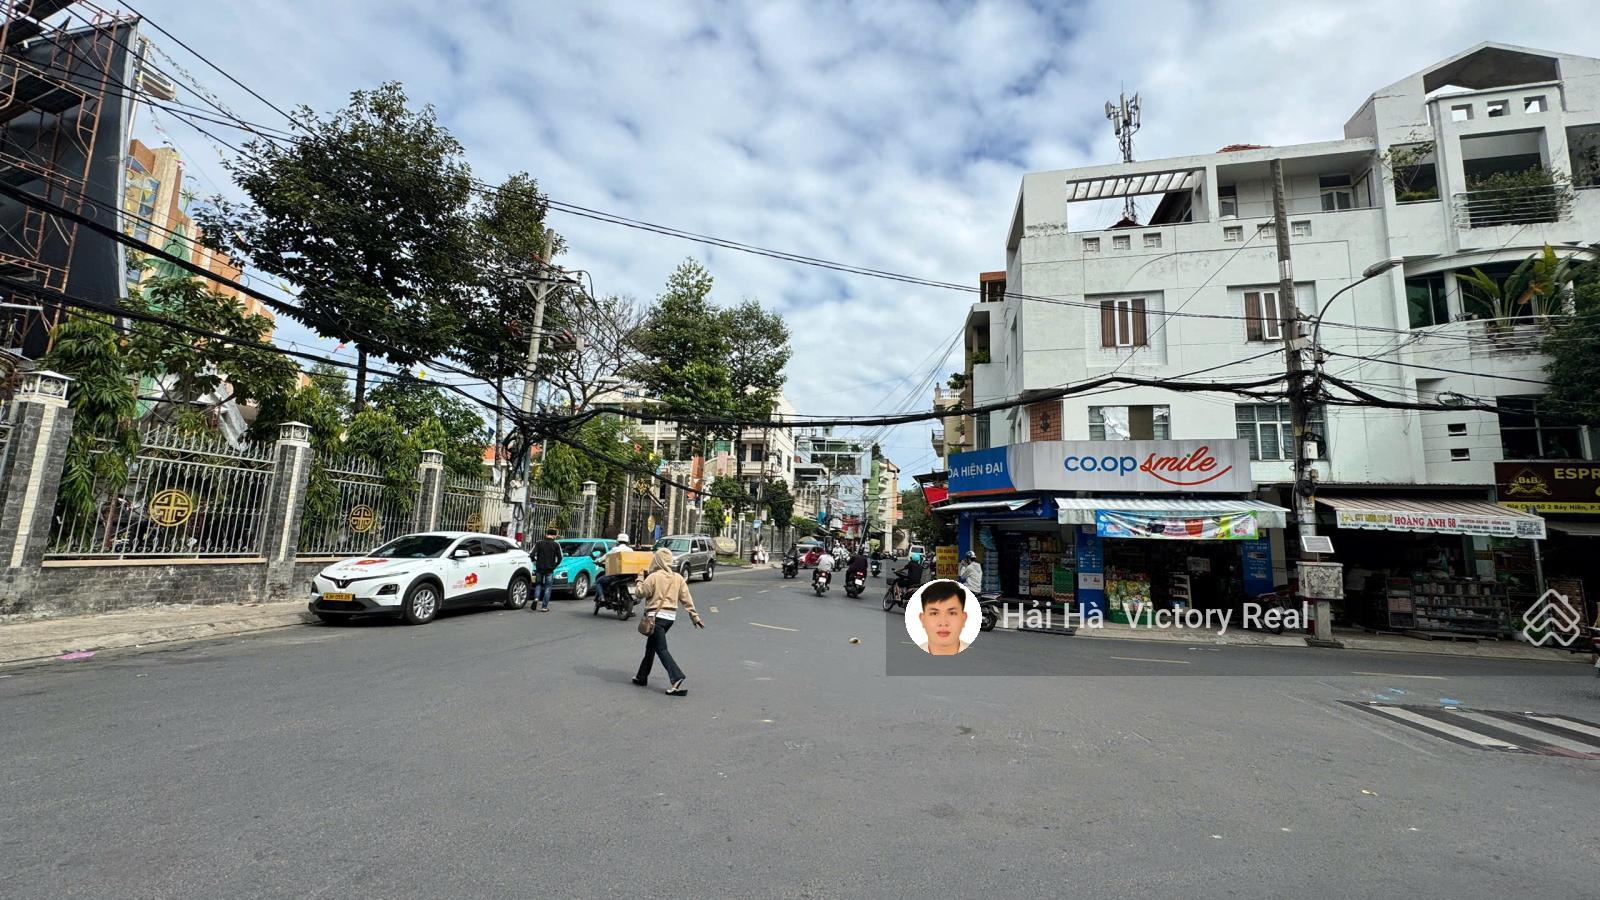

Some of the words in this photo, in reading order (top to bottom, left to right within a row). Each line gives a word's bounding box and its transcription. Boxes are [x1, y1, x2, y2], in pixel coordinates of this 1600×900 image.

[1064, 455, 1137, 476] co.op
[1139, 446, 1218, 473] smile
[961, 463, 982, 478] HIỆN
[985, 461, 1003, 477] ĐẠI
[1554, 468, 1600, 479] ESPR
[1394, 514, 1425, 526] HOÀNG
[1427, 518, 1446, 527] ANH
